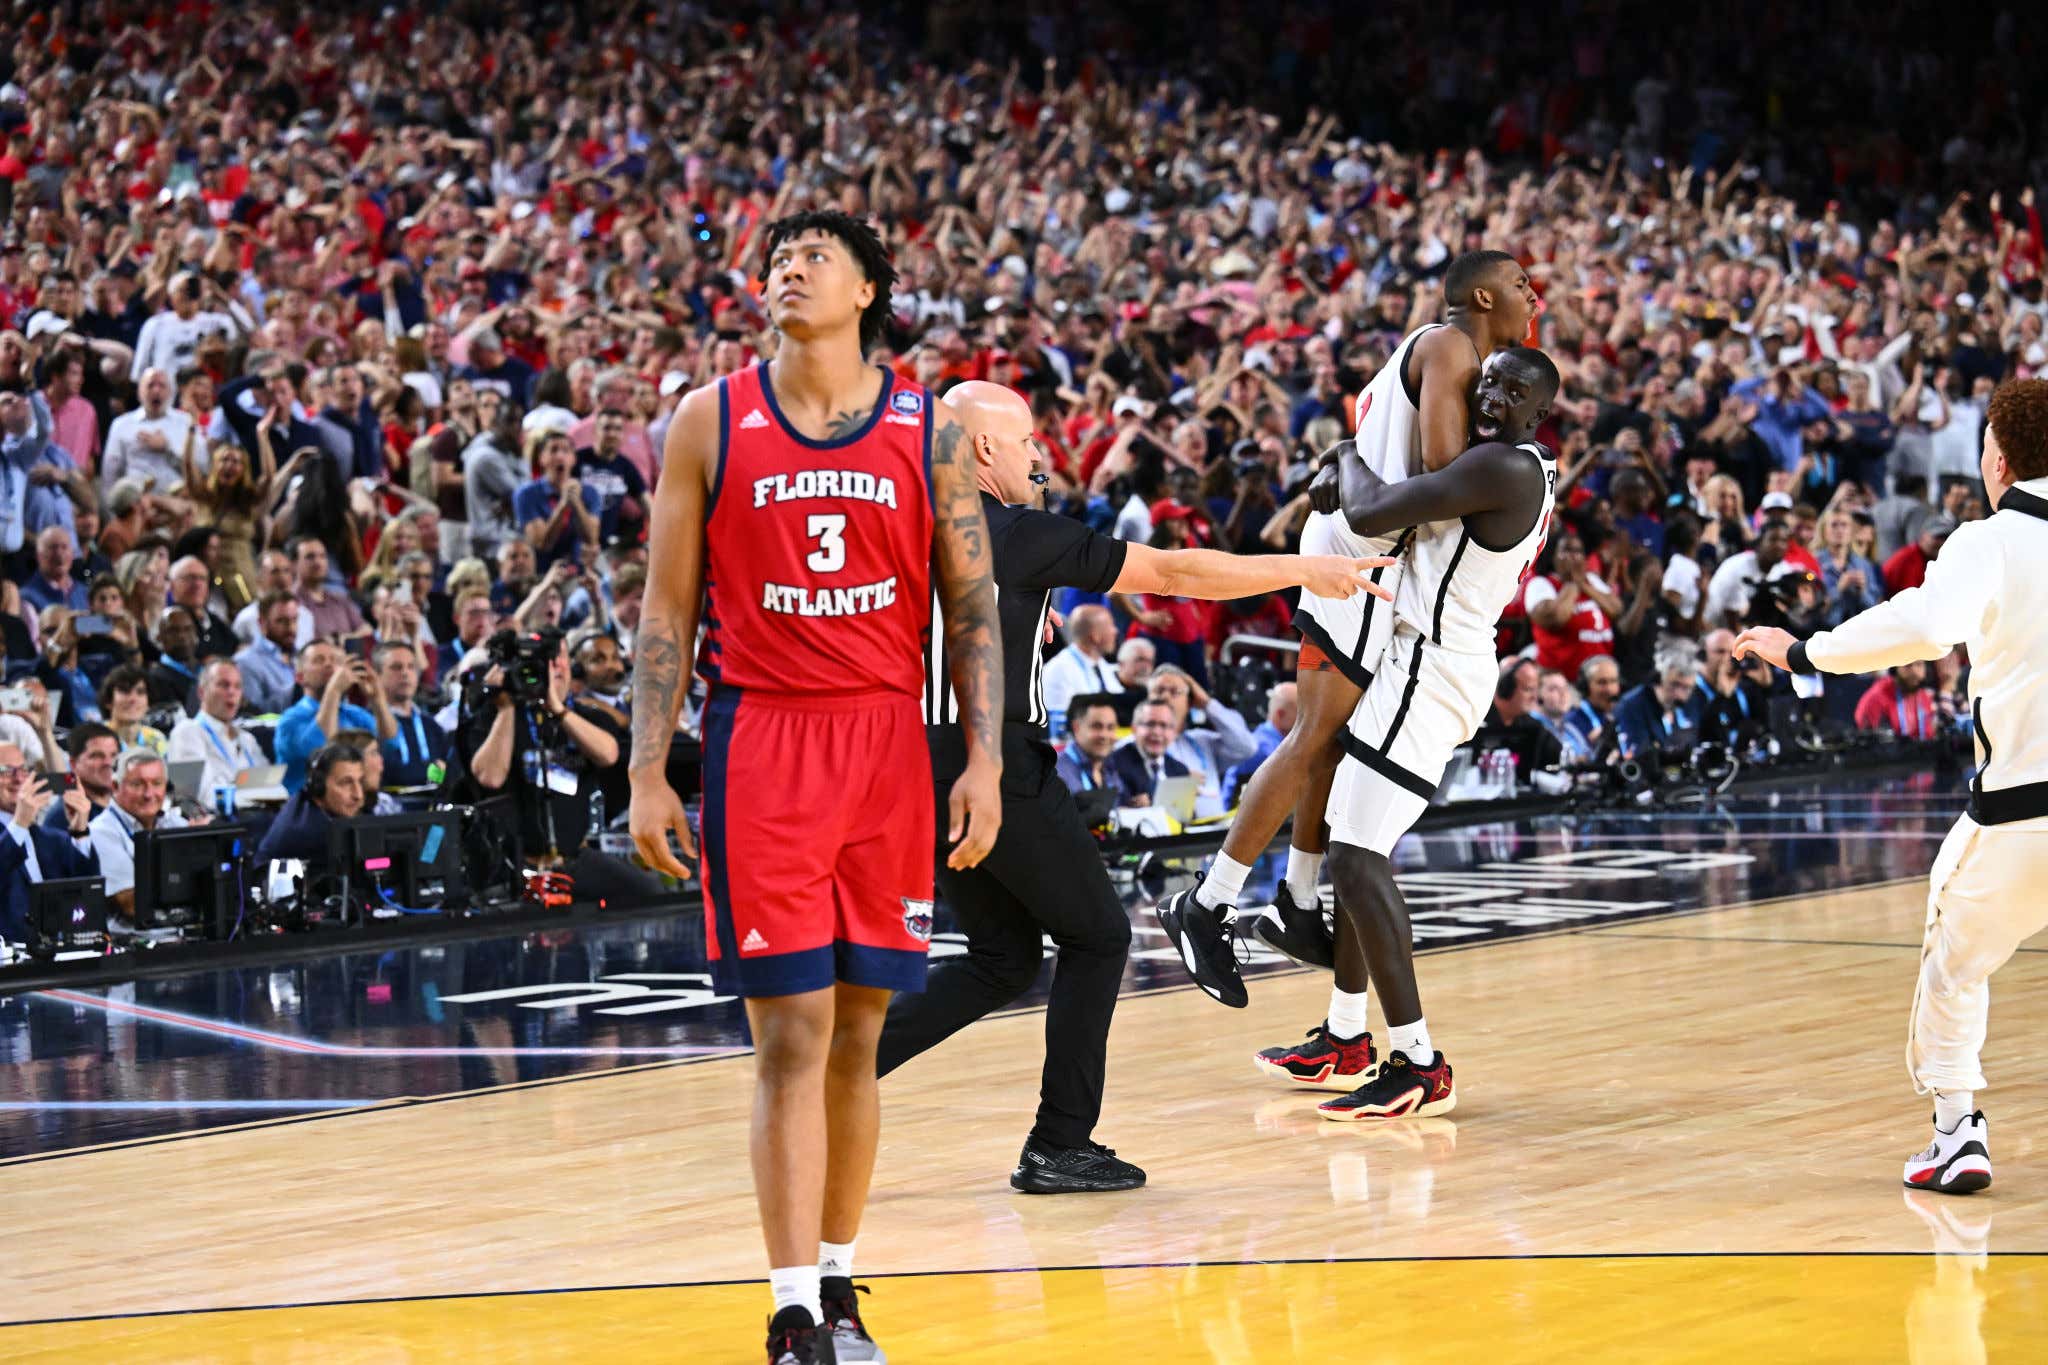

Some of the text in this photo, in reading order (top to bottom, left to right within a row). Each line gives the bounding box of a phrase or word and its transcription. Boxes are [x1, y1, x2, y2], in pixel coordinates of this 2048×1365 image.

[753, 470, 897, 510] FLORIDA
[806, 513, 847, 573] 3
[762, 576, 897, 616] ATLANTIC
